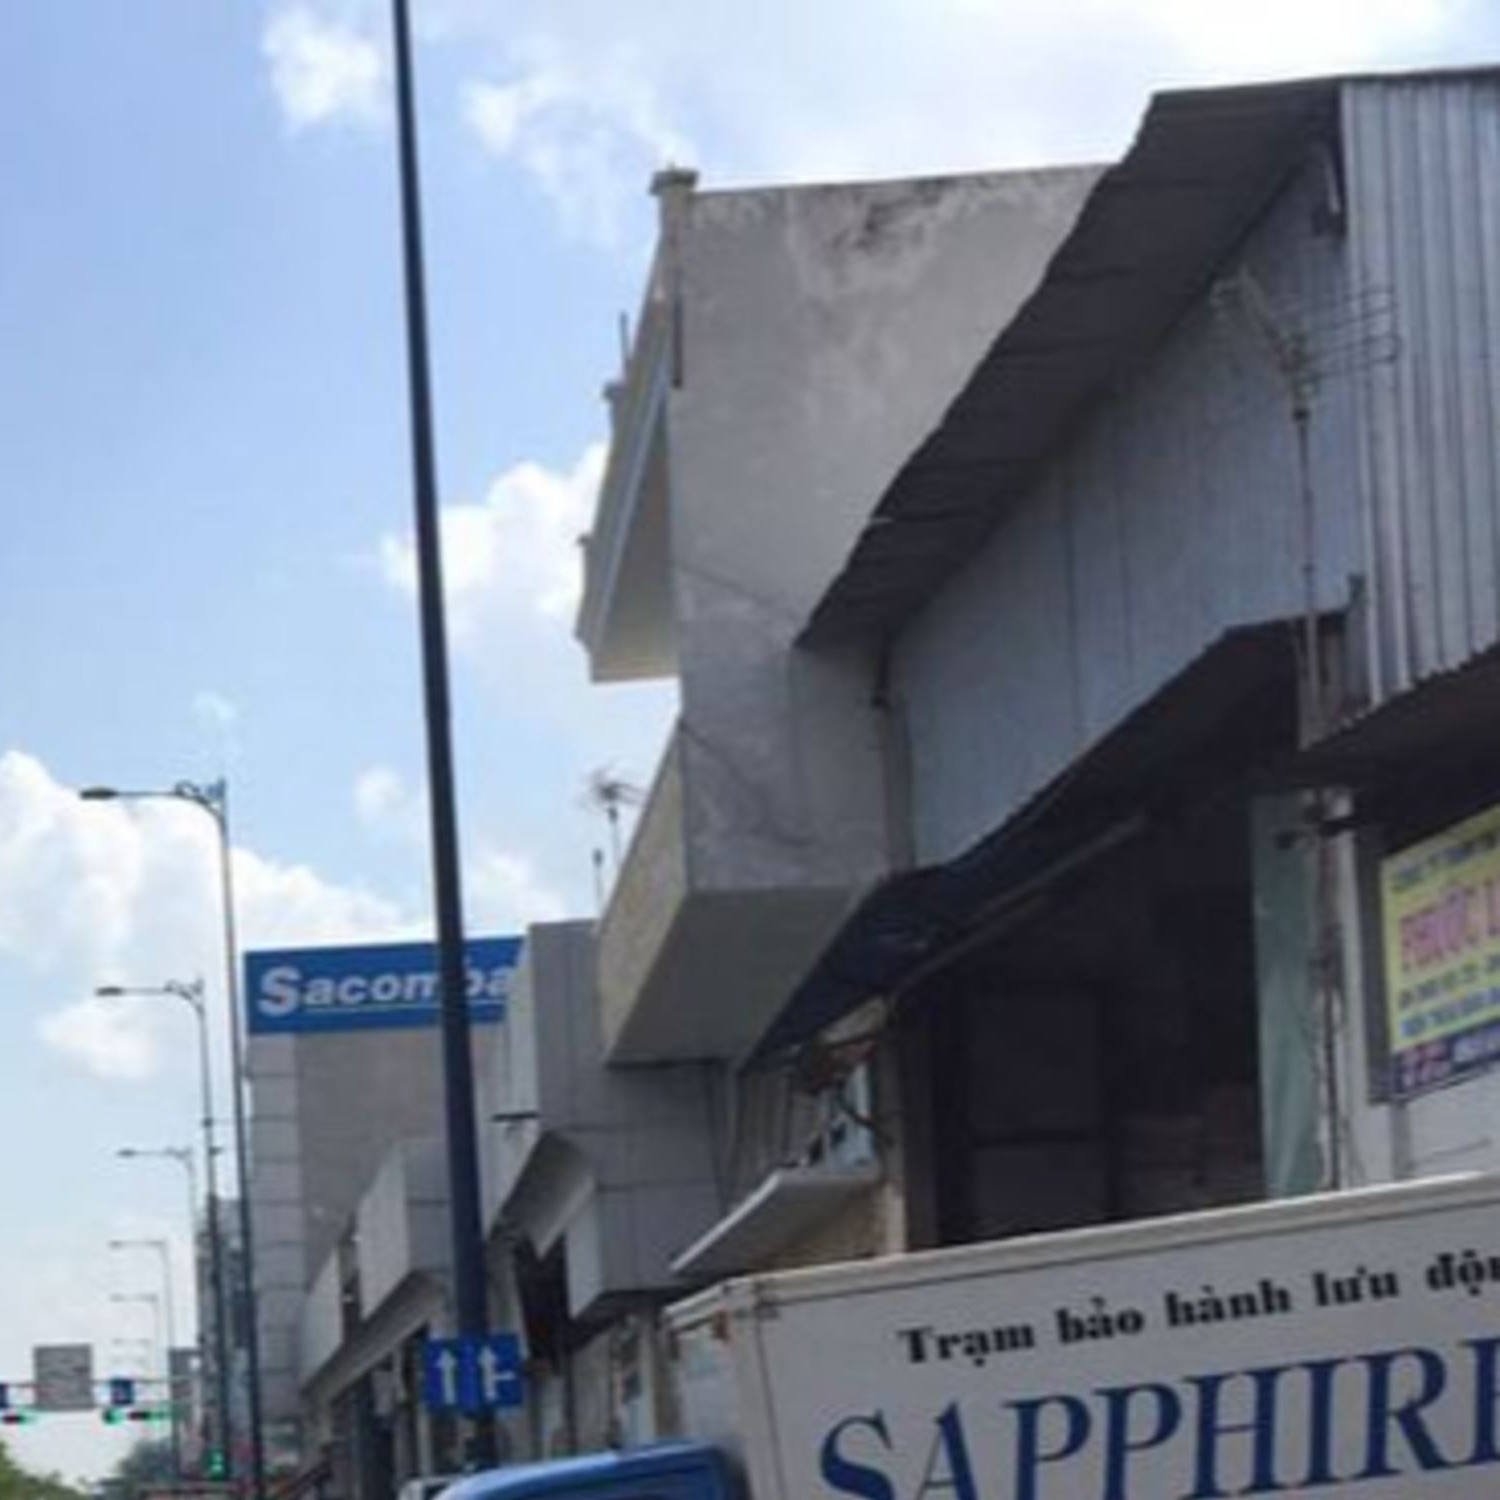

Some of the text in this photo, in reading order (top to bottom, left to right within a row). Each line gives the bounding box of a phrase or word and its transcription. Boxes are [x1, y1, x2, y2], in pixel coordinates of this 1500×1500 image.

[896, 1325, 1035, 1368] Trạm
[1055, 1296, 1145, 1344] bảo
[1164, 1278, 1291, 1327] hành
[1311, 1265, 1400, 1307] lưu
